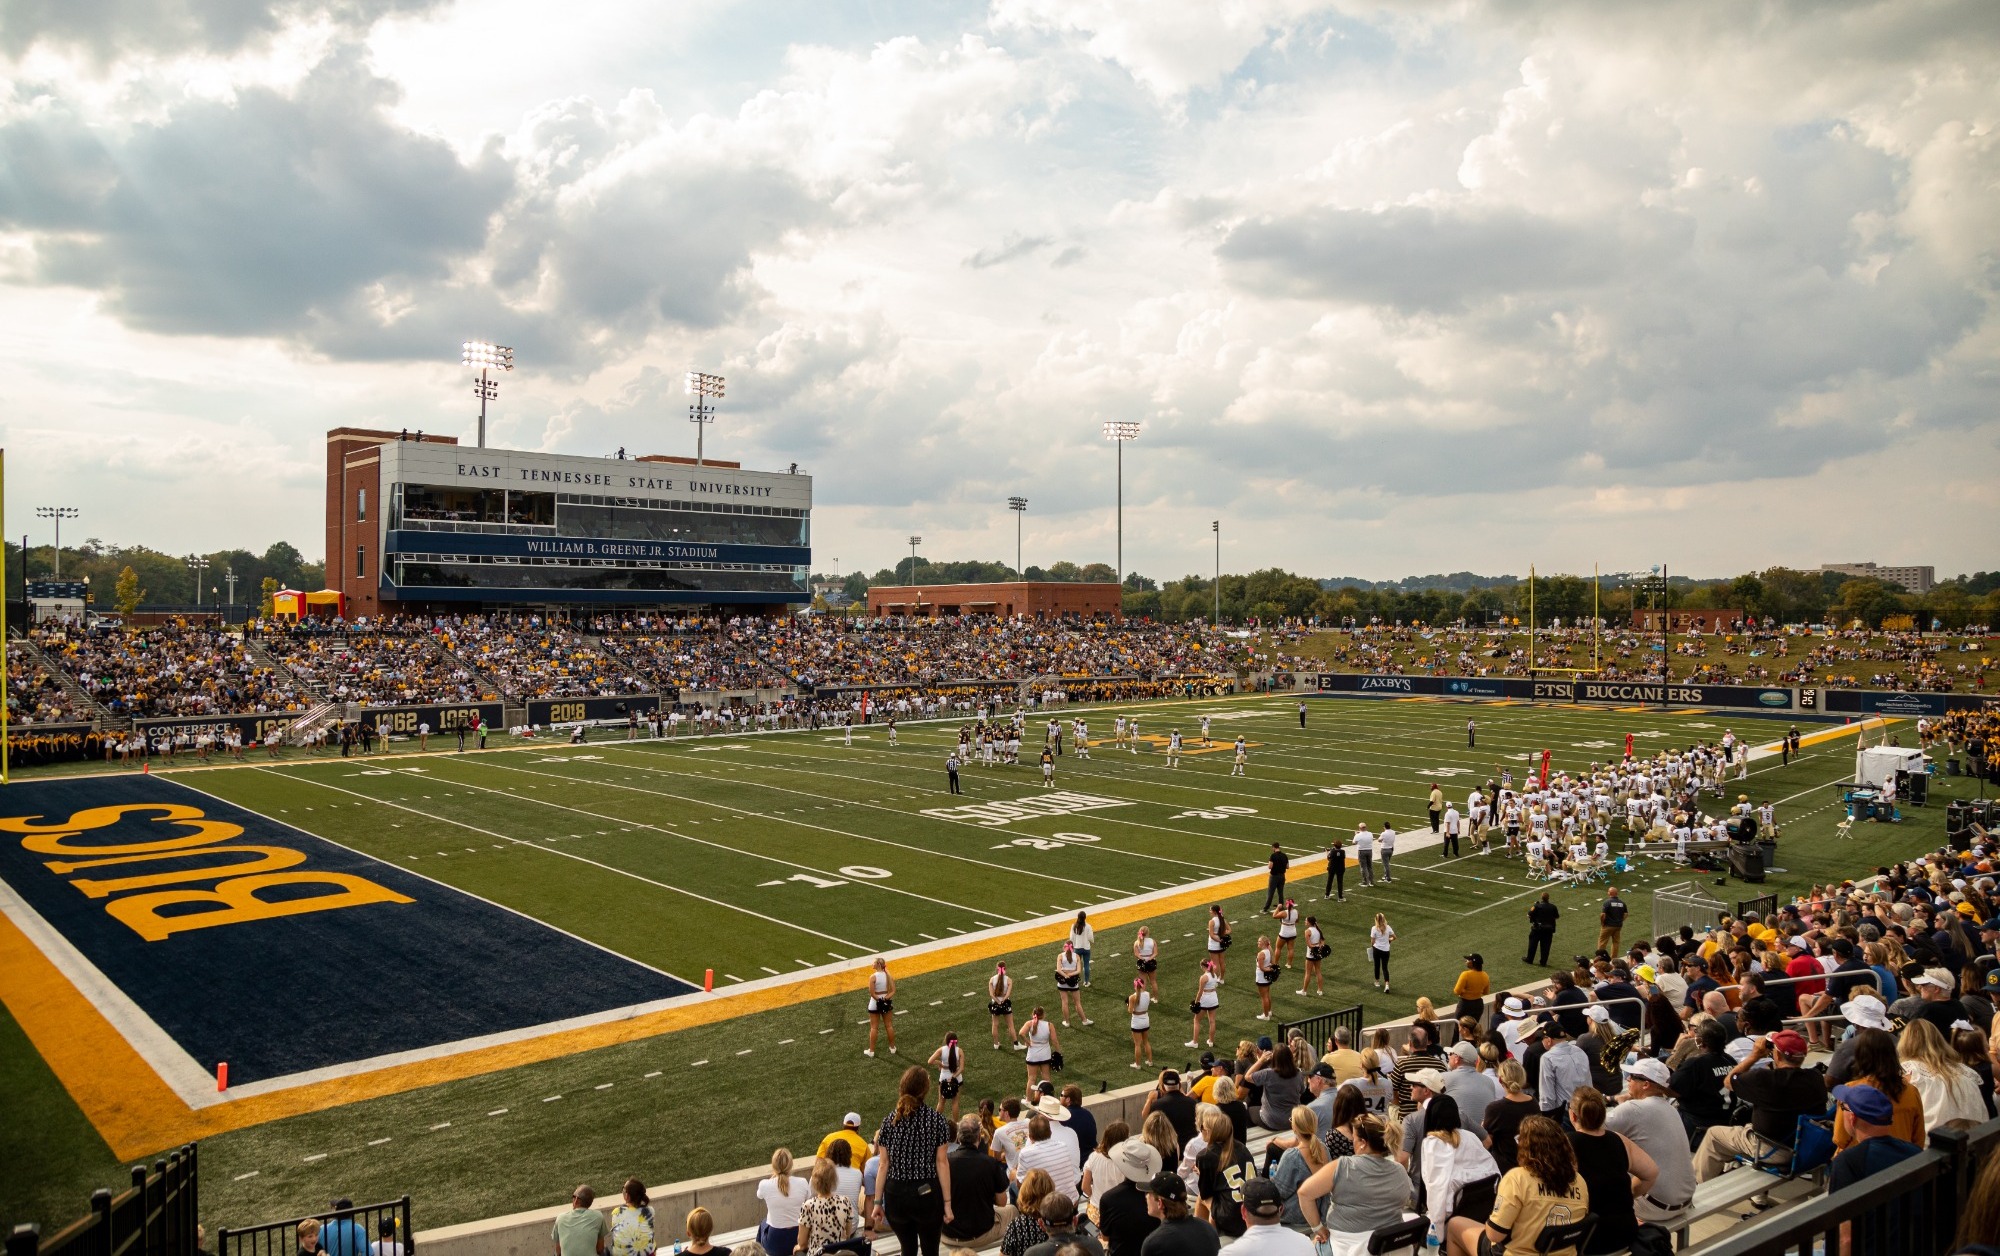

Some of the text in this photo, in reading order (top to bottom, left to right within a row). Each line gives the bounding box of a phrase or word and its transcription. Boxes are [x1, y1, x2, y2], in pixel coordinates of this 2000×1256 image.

[458, 464, 772, 497] EAST TENNESSEE STATE UNIVERSITY
[527, 541, 717, 558] WILLIAM B. GREENE JR. STADIUM
[1321, 677, 1331, 688] E
[1361, 677, 1411, 691] ZAXBY'S
[1801, 696, 1814, 705] 25
[551, 703, 586, 722] 2018
[1011, 832, 1102, 851] 20
[786, 865, 893, 889] 10
